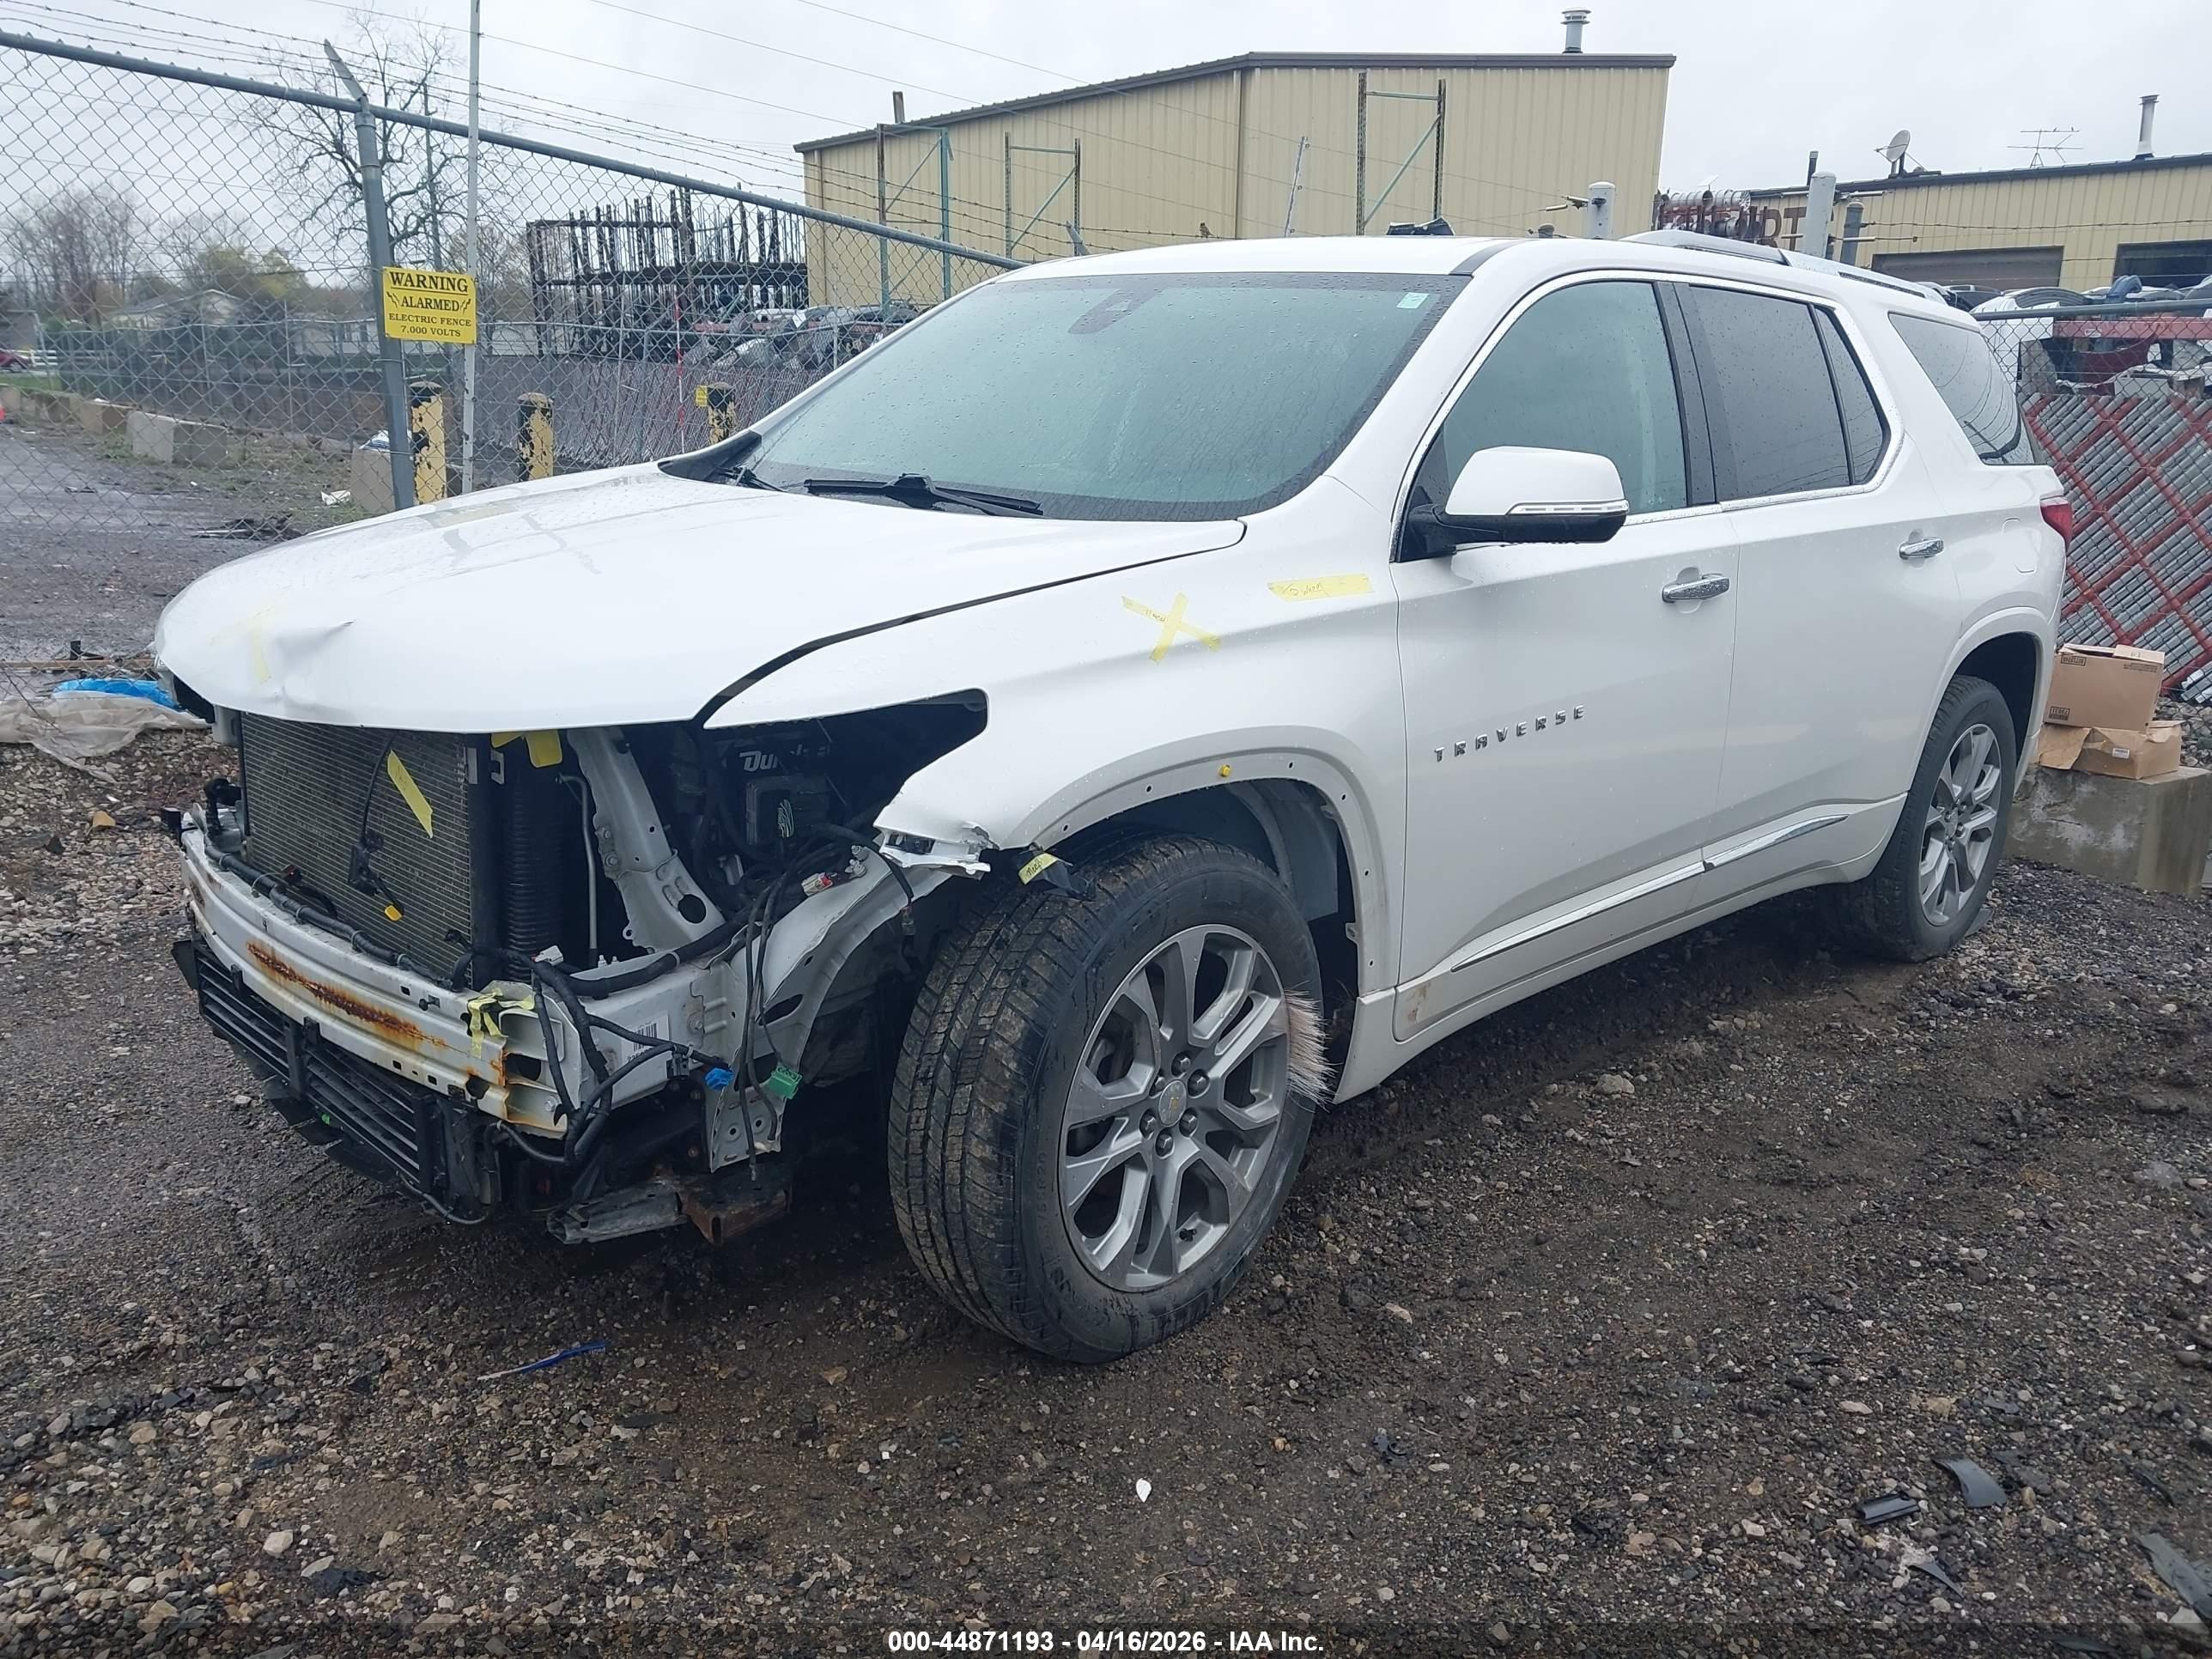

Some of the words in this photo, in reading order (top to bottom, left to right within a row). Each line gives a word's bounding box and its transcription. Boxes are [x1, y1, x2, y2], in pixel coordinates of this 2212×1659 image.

[389, 271, 468, 293] WARNING
[401, 295, 459, 312] ALARMED
[389, 313, 437, 324] ELECTRIC
[441, 317, 471, 327] FENCE
[400, 325, 428, 335] 7,000
[430, 327, 461, 337] VOLTS
[1434, 704, 1585, 763] TRAVERSE
